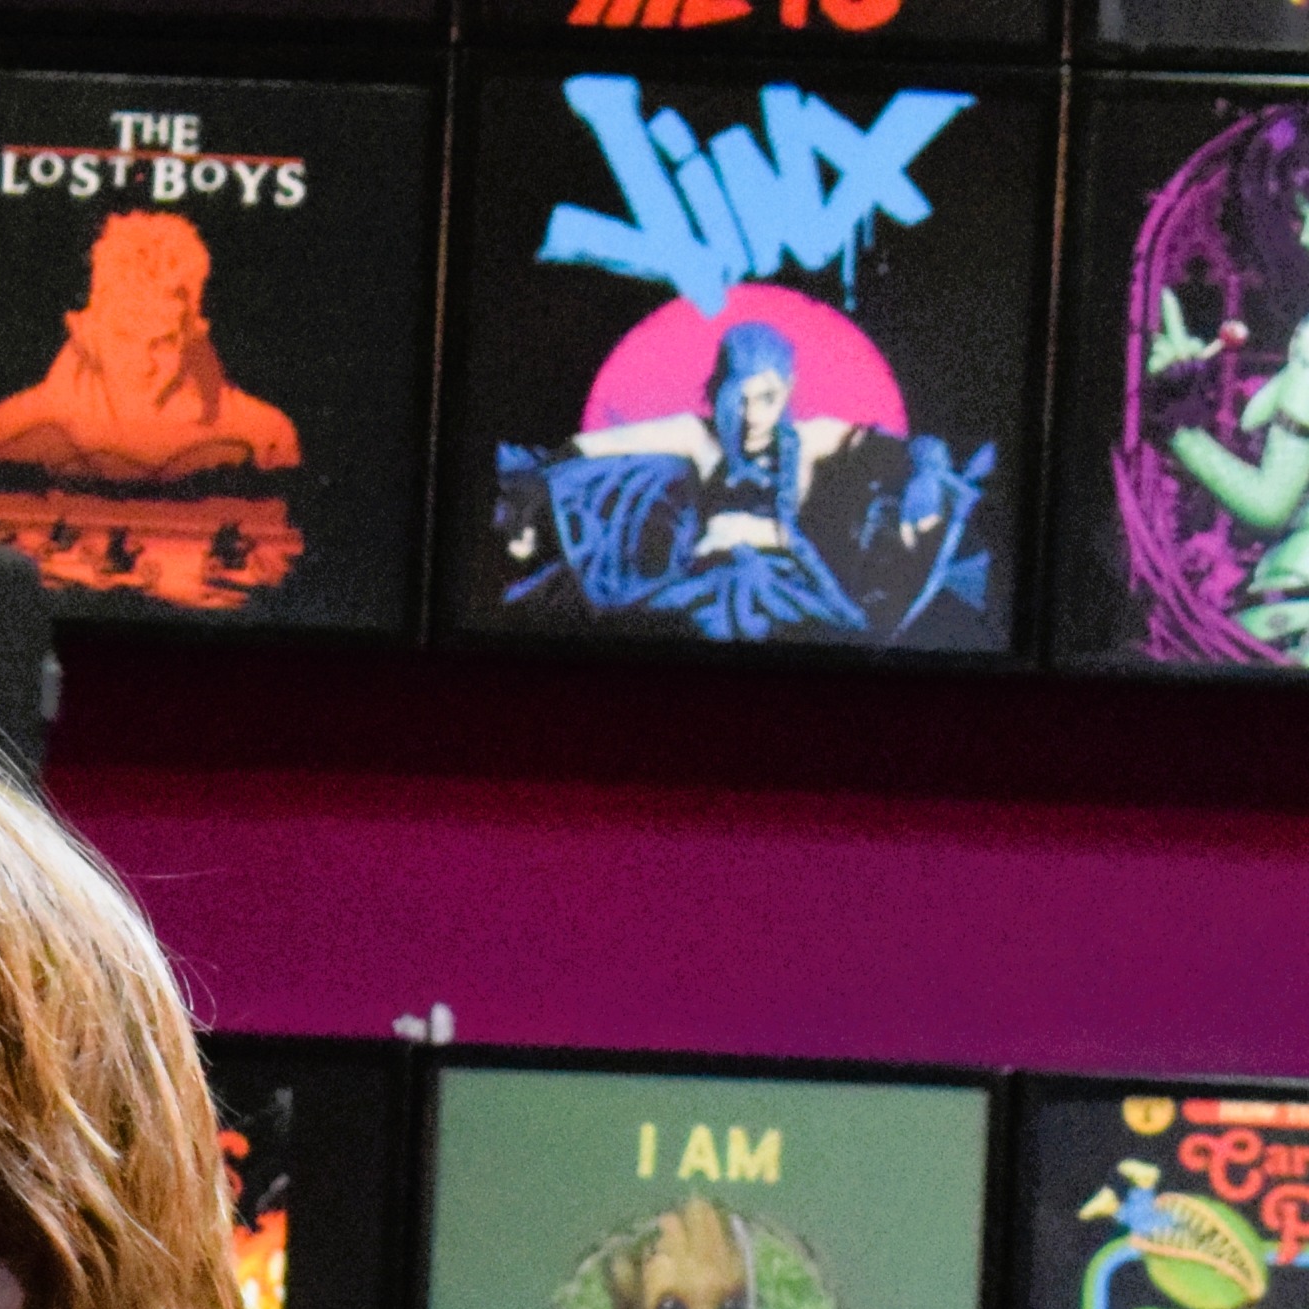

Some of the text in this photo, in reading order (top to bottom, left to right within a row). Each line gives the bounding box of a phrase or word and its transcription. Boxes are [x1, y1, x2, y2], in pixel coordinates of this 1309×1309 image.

[111, 111, 201, 155] THE
[1, 152, 308, 207] LOST BOYS
[636, 1123, 783, 1184] I AM
